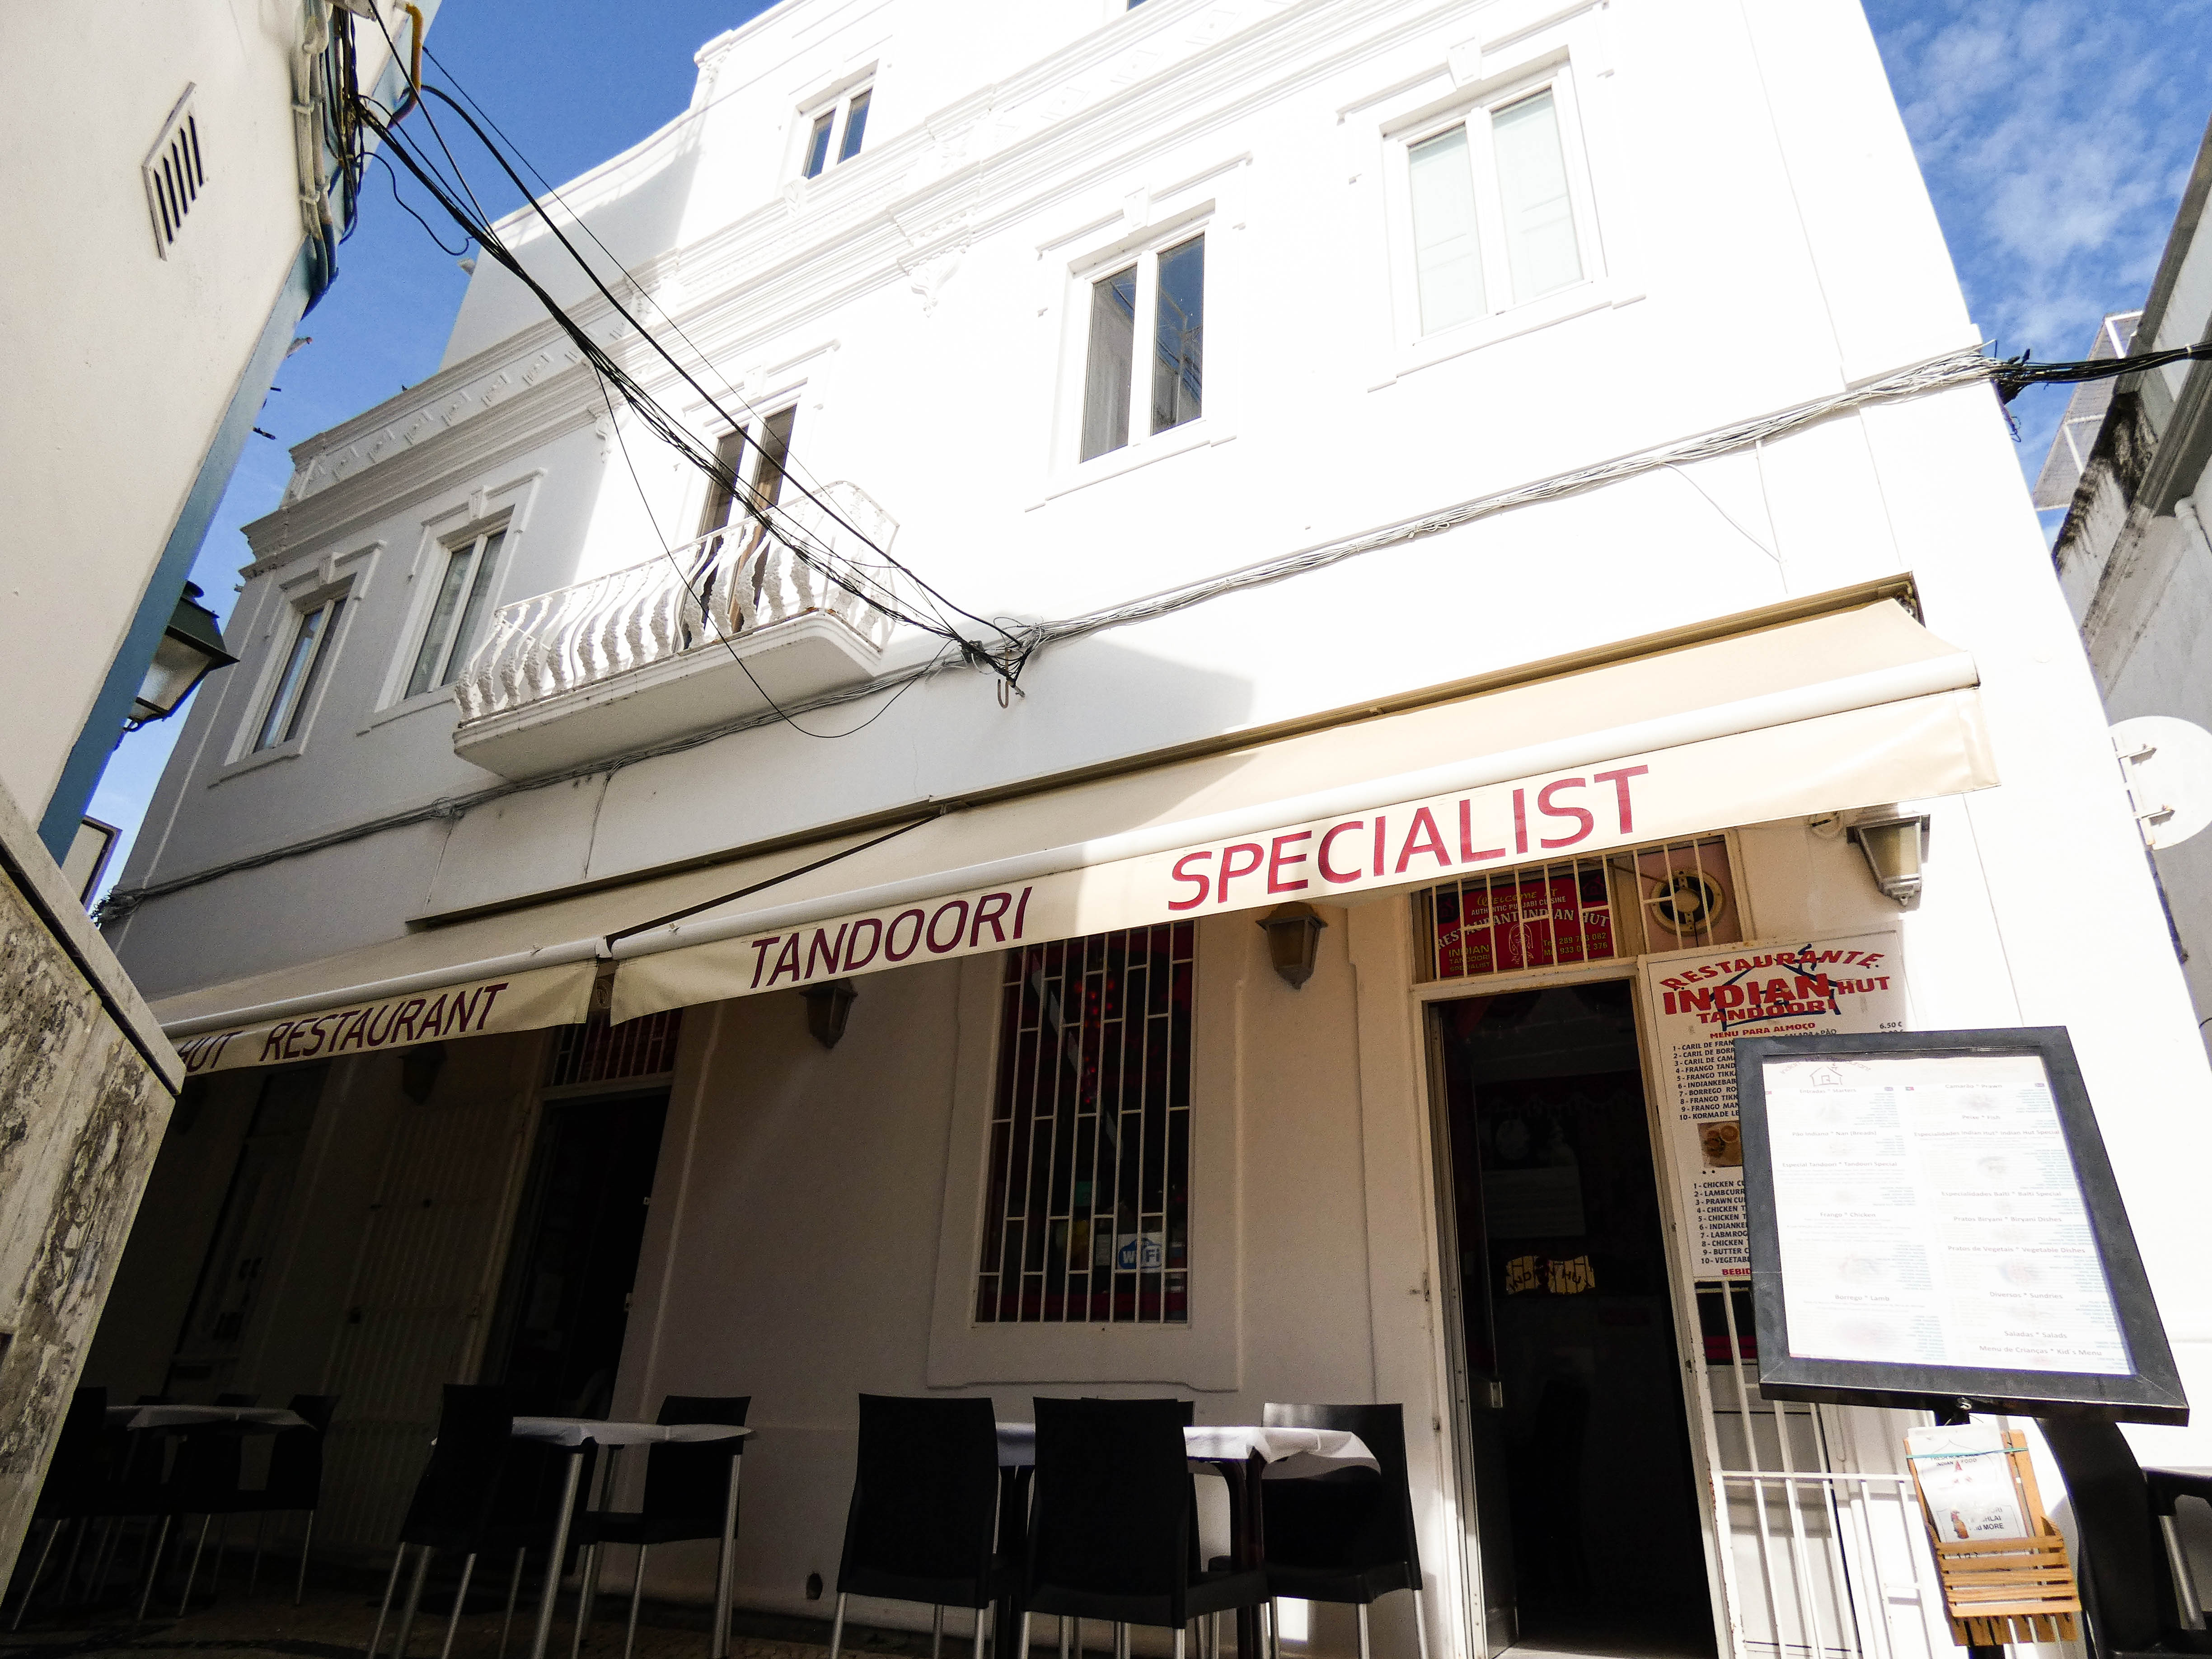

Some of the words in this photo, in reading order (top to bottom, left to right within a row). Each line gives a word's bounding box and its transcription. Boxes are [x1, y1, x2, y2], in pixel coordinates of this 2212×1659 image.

[750, 886, 1032, 989] TANDOORI
[1168, 764, 1650, 911] SPECIALIST
[1472, 905, 1507, 916] AUTHNTIC
[1509, 901, 1537, 909] PUJABI
[1539, 896, 1566, 904] CUSINE
[1523, 908, 1575, 921] INDAN
[1575, 935, 1589, 943] 73
[1576, 944, 1591, 952] 02
[1659, 950, 1885, 989] RESTAURANTE
[1663, 973, 1830, 1015] INDIAN
[1835, 976, 1890, 995] HUT
[1696, 998, 1837, 1024] TANDOORI
[178, 1031, 243, 1072] HUT
[259, 983, 508, 1062] RESTAURANT
[1710, 1030, 1739, 1039] MENU
[1743, 1027, 1771, 1036] PARA
[1774, 1022, 1816, 1033] ALMOÇO
[1687, 1072, 1715, 1080] FRANGO
[1689, 1087, 1722, 1096] BORREGO
[1690, 1096, 1719, 1104] FRANGO
[1692, 1103, 1720, 1111] FRANGO
[2015, 1347, 2048, 1355] Crianças
